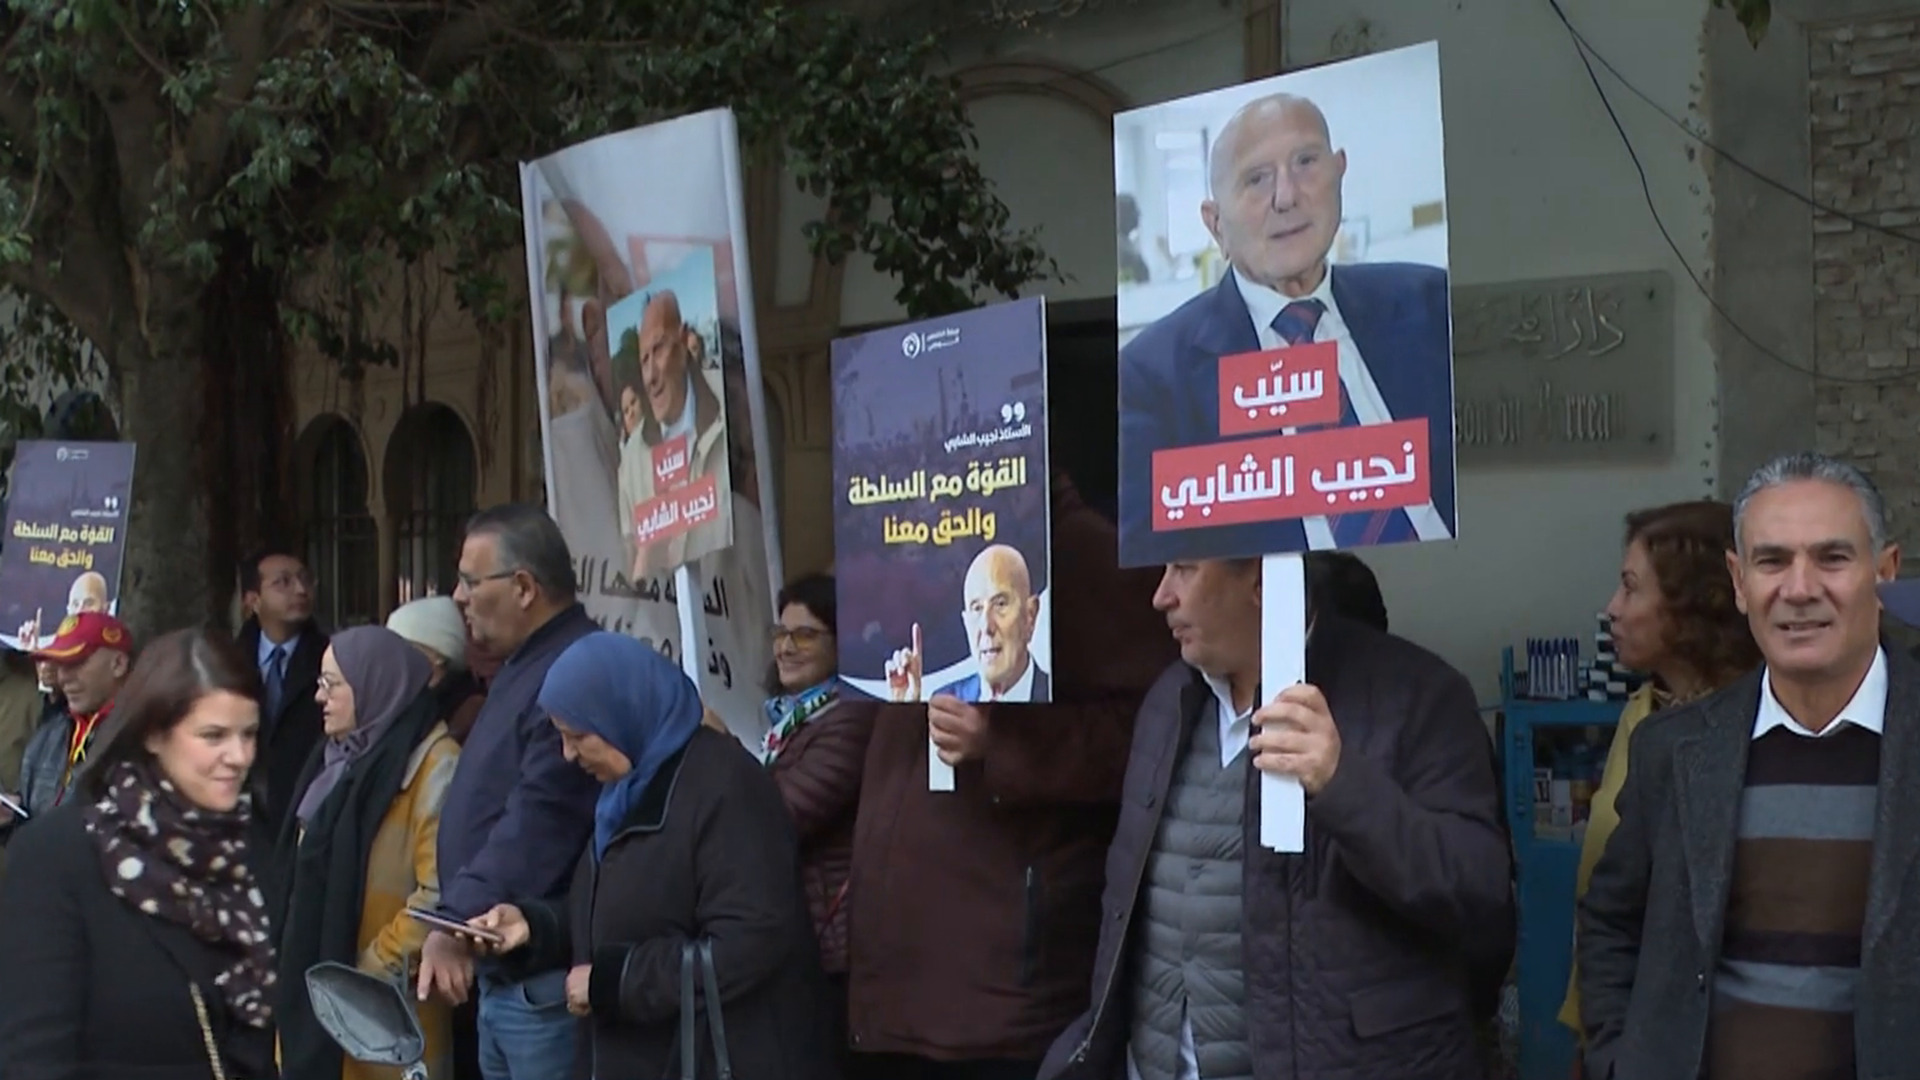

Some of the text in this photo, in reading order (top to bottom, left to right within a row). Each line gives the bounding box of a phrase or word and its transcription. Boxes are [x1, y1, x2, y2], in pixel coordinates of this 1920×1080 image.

[1233, 359, 1324, 419] سيّب
[849, 469, 926, 505] السلطة
[930, 473, 963, 503] مع
[1161, 441, 1416, 520] نجيب الشابي
[13, 520, 59, 541] السلطة
[637, 486, 715, 542] نجيب الشابي
[884, 507, 996, 546] والحق معنا
[58, 529, 79, 544] مع
[29, 546, 94, 570] والحق معنا
